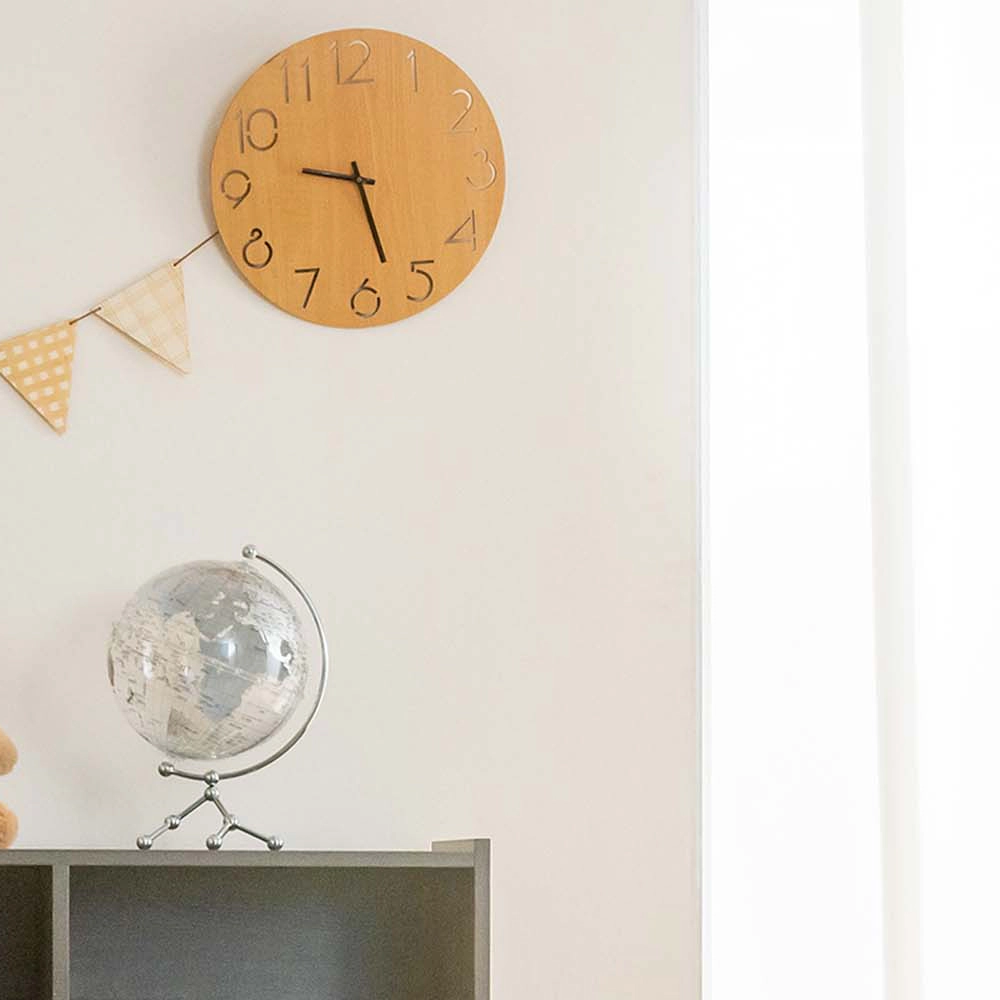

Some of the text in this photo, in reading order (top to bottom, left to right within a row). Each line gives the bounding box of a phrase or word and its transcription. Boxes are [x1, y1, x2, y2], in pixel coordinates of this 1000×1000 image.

[279, 56, 312, 104] 11
[328, 39, 375, 85] 12
[406, 48, 418, 92] 1
[236, 107, 279, 154] 10
[450, 88, 477, 134] 2
[220, 169, 252, 209] 9
[465, 149, 498, 191] 3
[242, 227, 274, 270] 8
[444, 208, 478, 252] 4
[294, 267, 321, 309] 7
[350, 277, 382, 319] 6
[406, 259, 435, 302] 5
